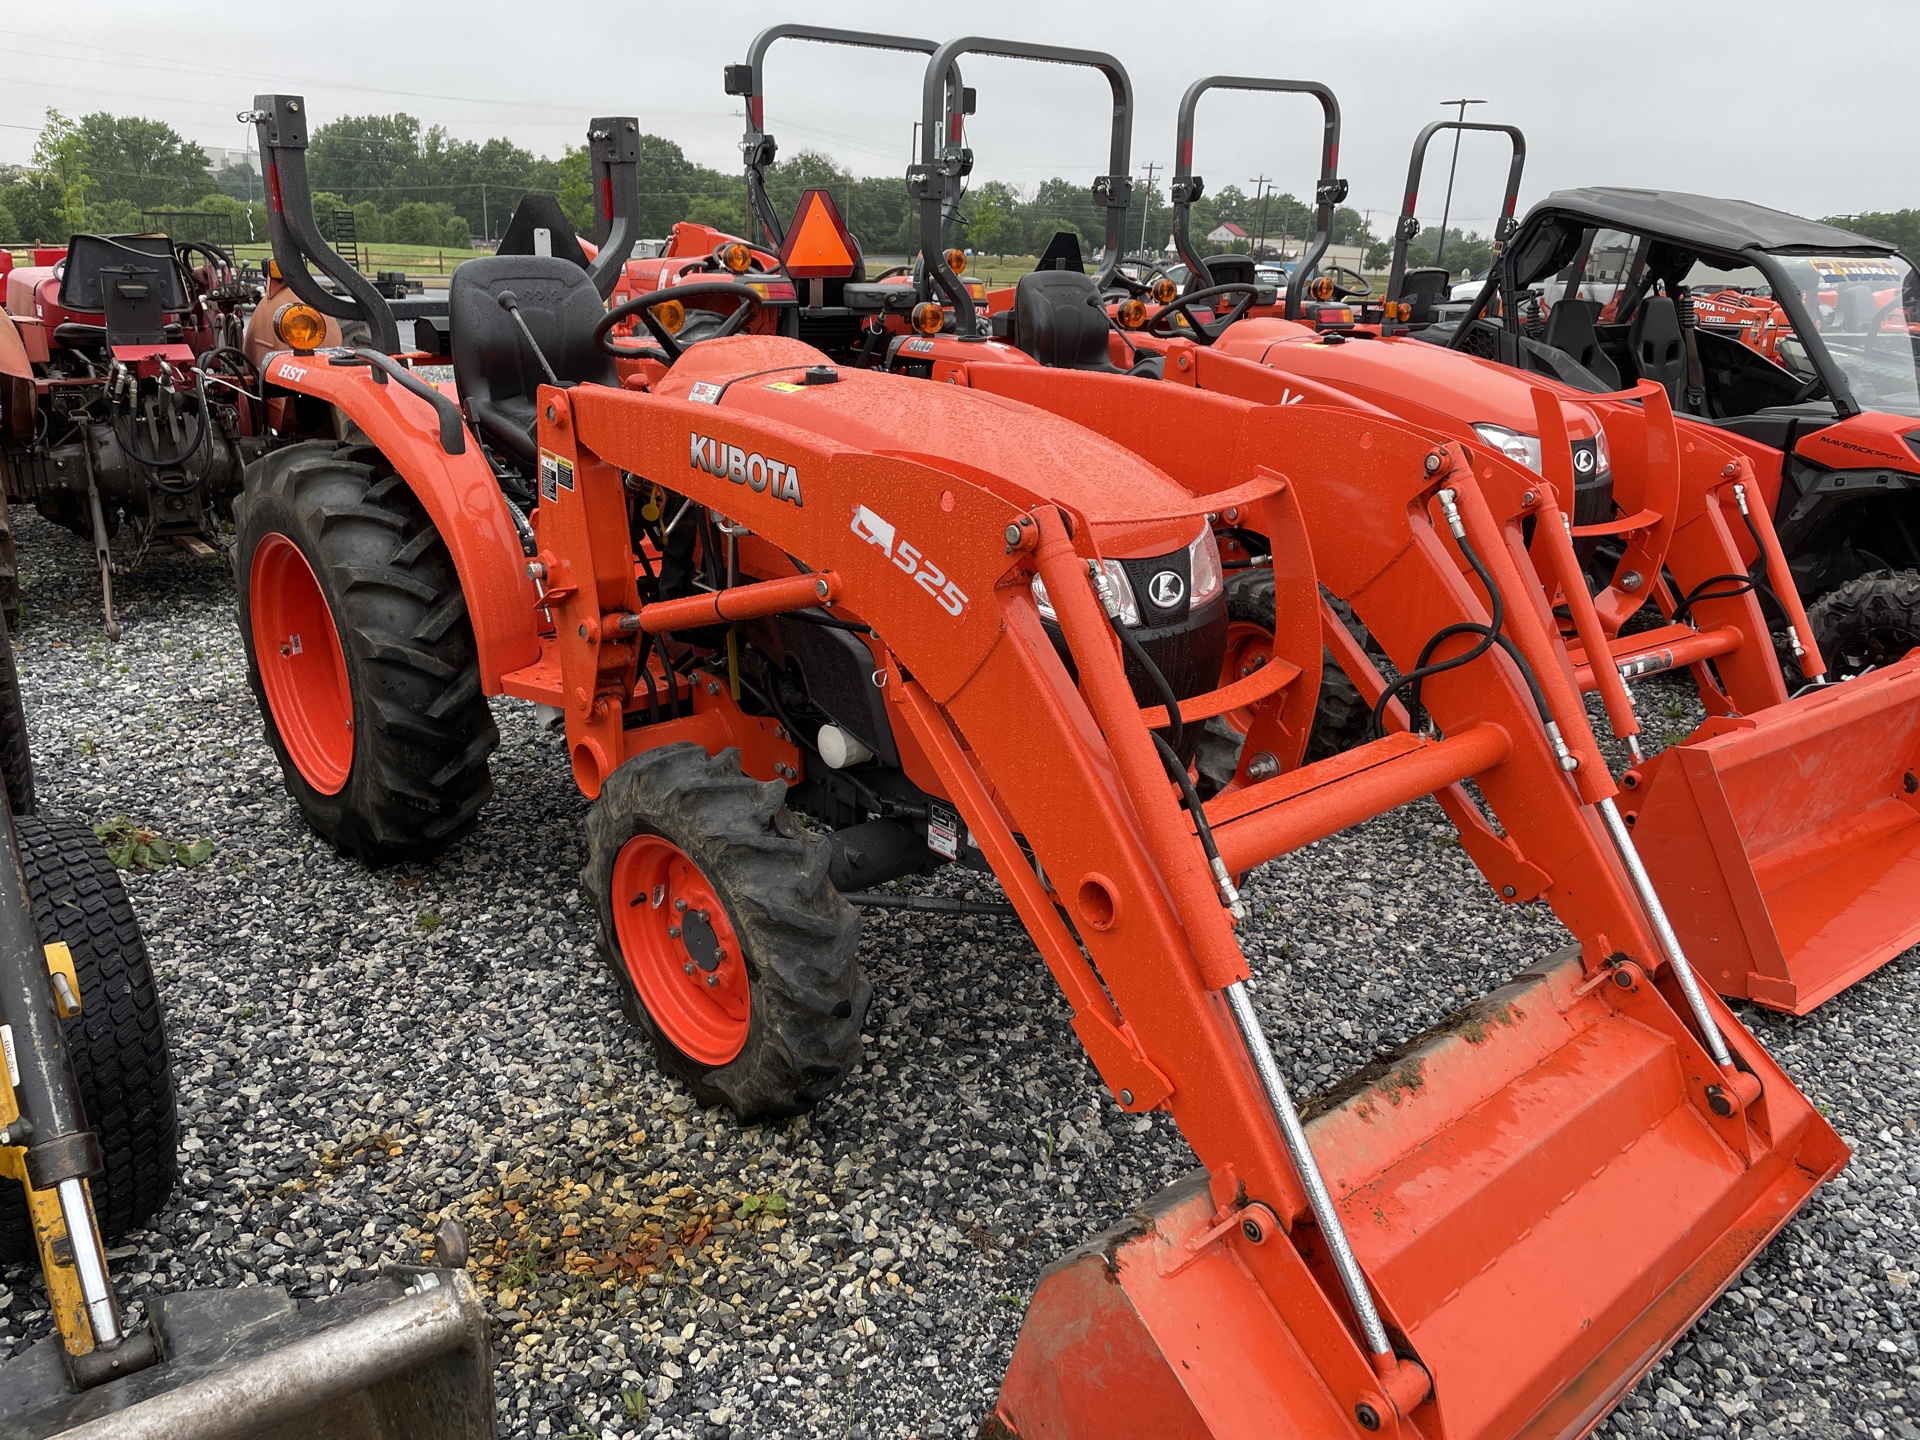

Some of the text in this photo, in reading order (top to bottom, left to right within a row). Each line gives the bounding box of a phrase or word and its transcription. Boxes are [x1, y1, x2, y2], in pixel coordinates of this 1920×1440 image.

[907, 340, 934, 353] 4WD
[278, 363, 307, 382] HST
[1820, 436, 1904, 461] MAVERICK SPORT
[690, 431, 803, 508] KUBOTA
